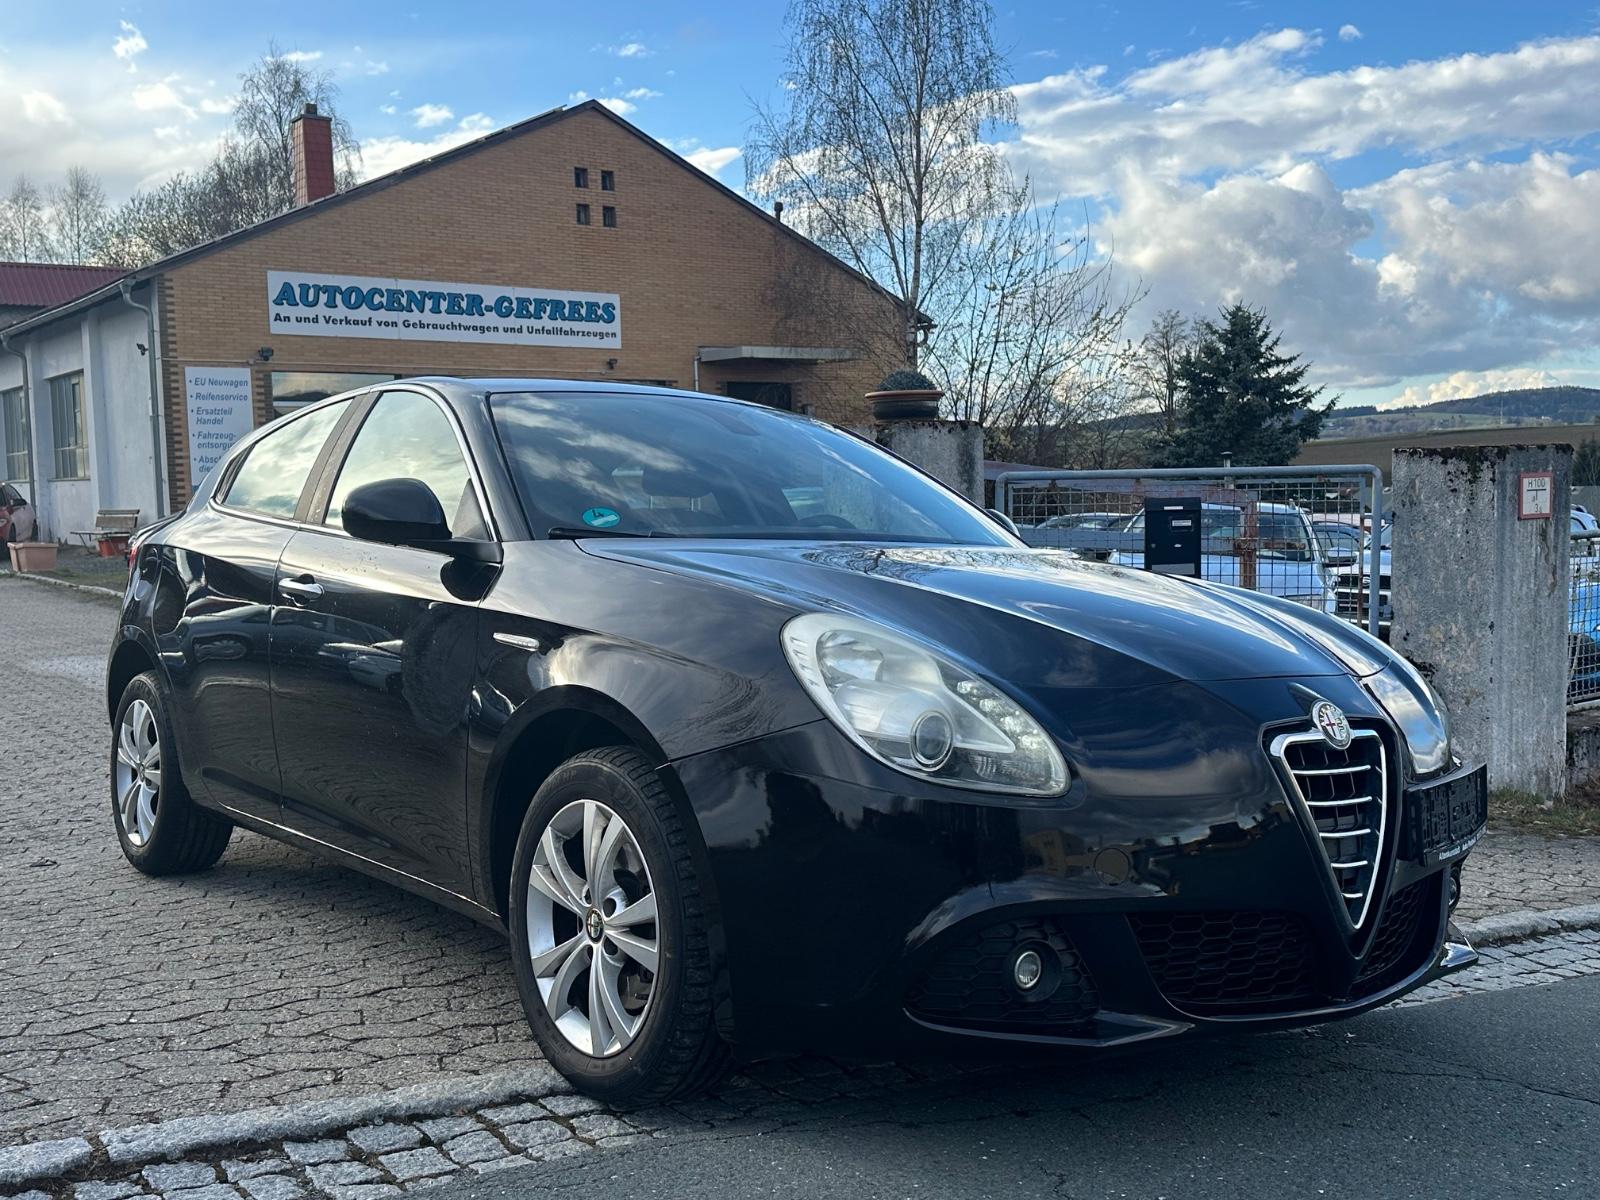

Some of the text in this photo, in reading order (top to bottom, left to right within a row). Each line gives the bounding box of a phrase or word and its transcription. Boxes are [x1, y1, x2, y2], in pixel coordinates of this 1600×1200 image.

[272, 281, 616, 324] AUTOCENTER-GEFREES
[273, 312, 617, 340] An und Verkauf von Gebrauchtwagen und Unfallfahrzeugen
[194, 377, 249, 388] EU Neuwagen
[195, 392, 249, 401] Reifenservice
[196, 406, 233, 416] Ersatzteil
[196, 417, 224, 425] Handel
[197, 431, 237, 441] Fahrzeug-
